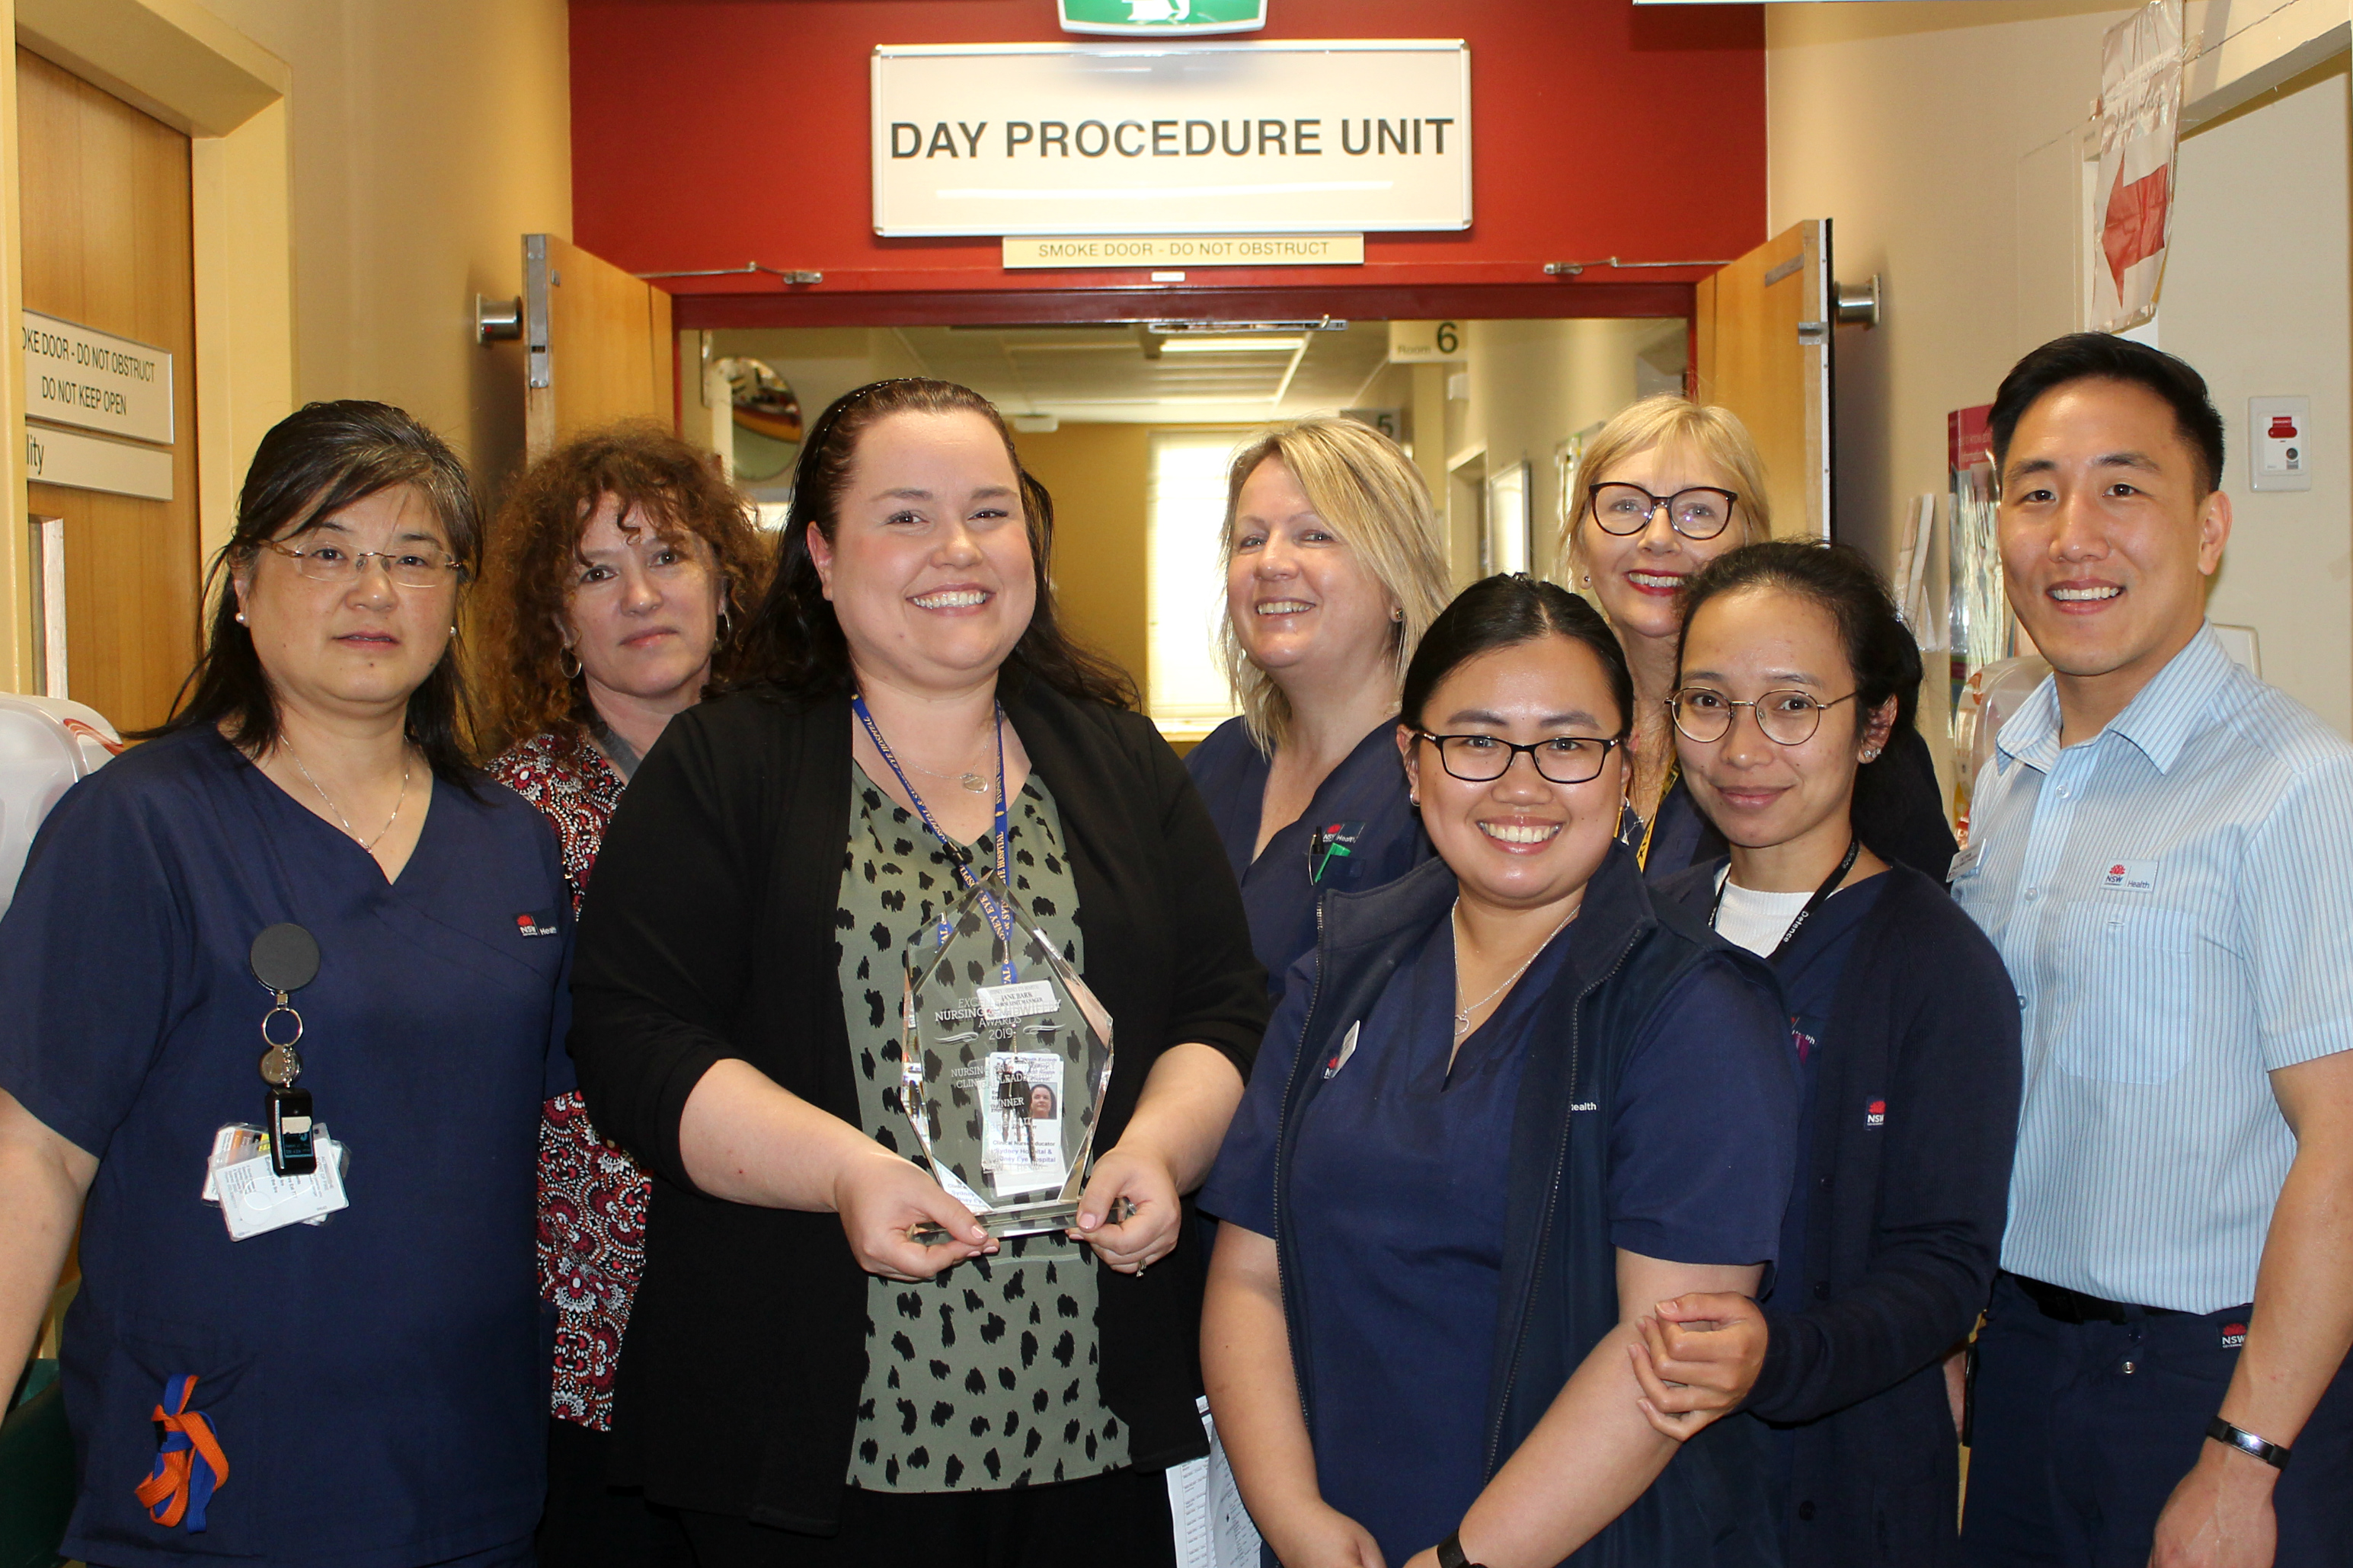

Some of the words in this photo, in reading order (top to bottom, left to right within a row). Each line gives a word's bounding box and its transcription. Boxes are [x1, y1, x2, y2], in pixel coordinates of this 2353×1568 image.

[890, 121, 987, 159] DAY
[1005, 119, 1323, 158] PROCEDURE
[1341, 118, 1454, 155] UNIT
[1039, 244, 1099, 257] SMOKE
[1104, 243, 1153, 257] DOOR
[1170, 242, 1194, 256] DO
[1200, 242, 1233, 256] NOT
[1239, 241, 1330, 256] OBSTRUCT
[1397, 344, 1432, 356] Room
[1437, 321, 1459, 354] 6
[42, 333, 69, 361] DOOR
[77, 342, 91, 366] DO
[92, 346, 110, 370] NOT
[111, 353, 155, 383] OBSTRUCT
[42, 375, 56, 401] DO
[58, 380, 77, 405] NOT
[78, 385, 101, 410] KEEP
[104, 391, 127, 416] OPEN
[1378, 414, 1394, 438] 5
[996, 832, 1006, 869] HOSPITAL
[2105, 875, 2124, 883] NSW
[2128, 880, 2150, 889] Health
[979, 895, 996, 915] EYE
[934, 1007, 984, 1023] NURSING
[978, 1015, 1022, 1028] AWARDS
[988, 1028, 1014, 1040] 2019
[1867, 1114, 1885, 1123] NSW
[2222, 1334, 2246, 1345] NSW
